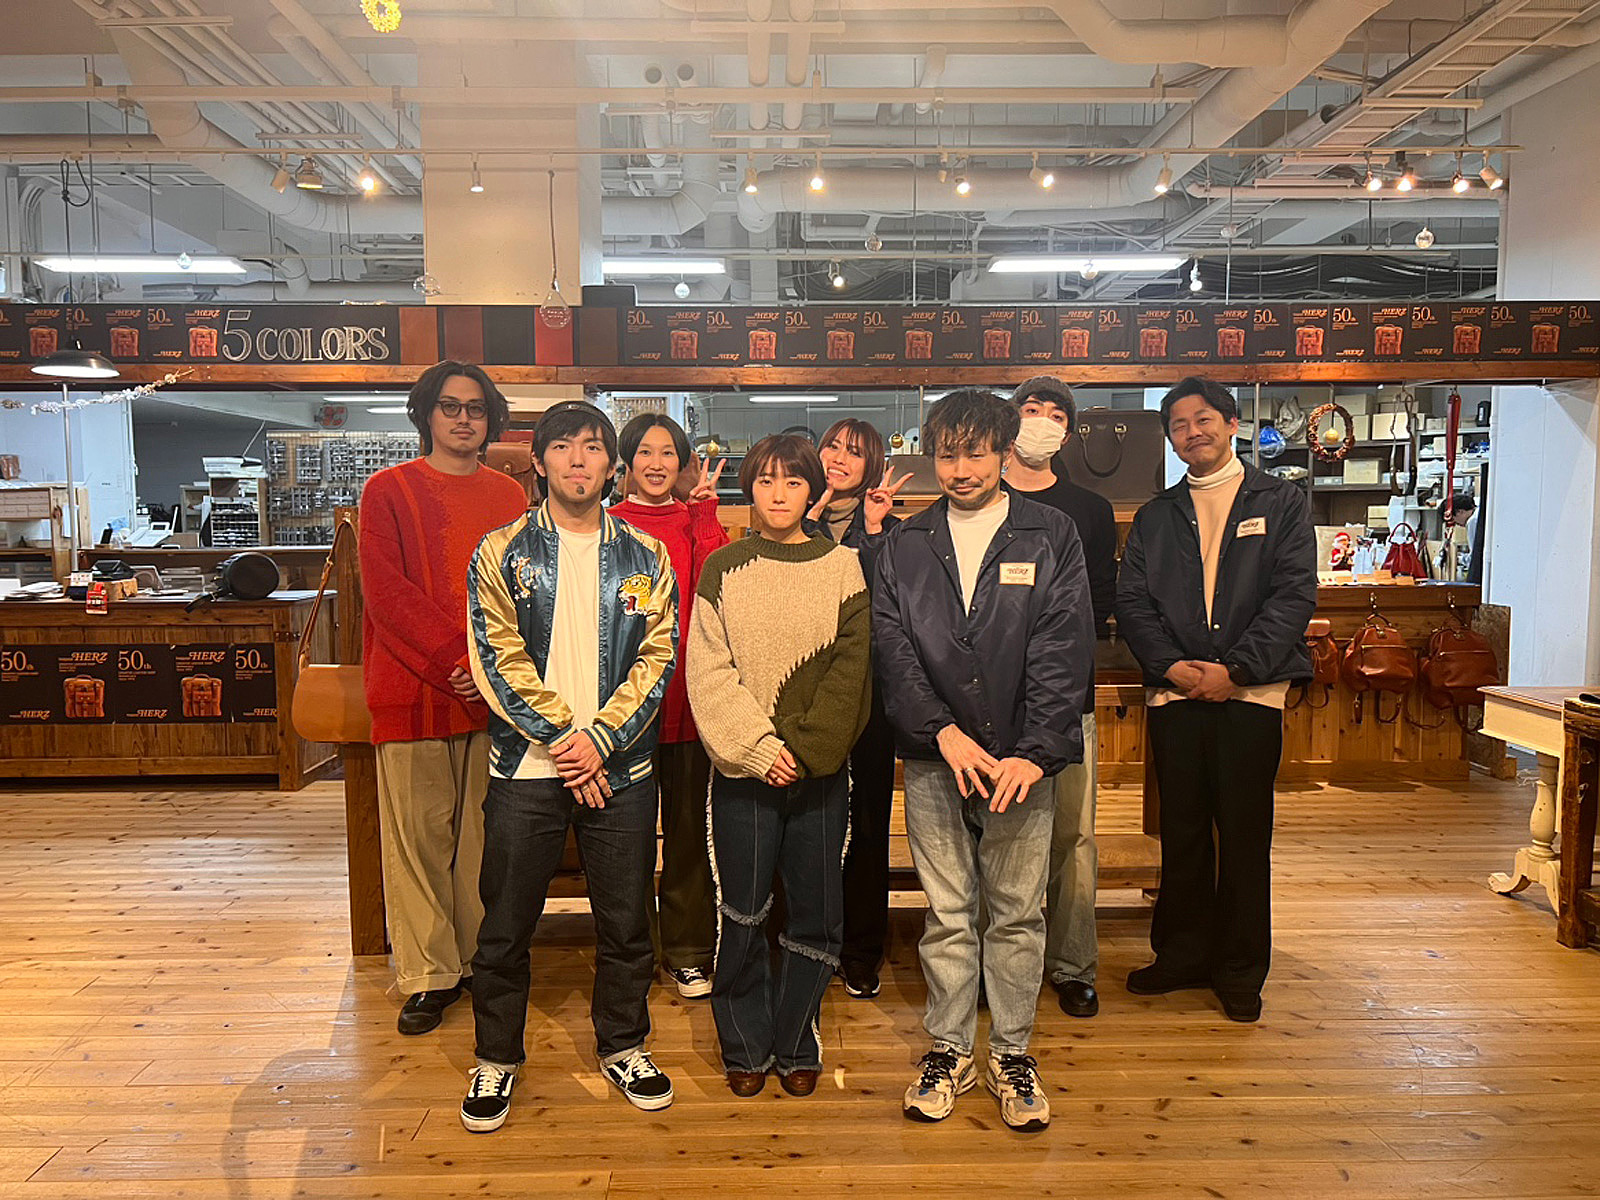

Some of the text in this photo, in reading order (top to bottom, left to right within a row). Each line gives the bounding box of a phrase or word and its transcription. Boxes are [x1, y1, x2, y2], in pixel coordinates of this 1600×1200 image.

[222, 309, 390, 361] 5 COLORS
[71, 652, 108, 664] HERZ
[189, 651, 226, 663] HERZ
[253, 708, 277, 717] HER
